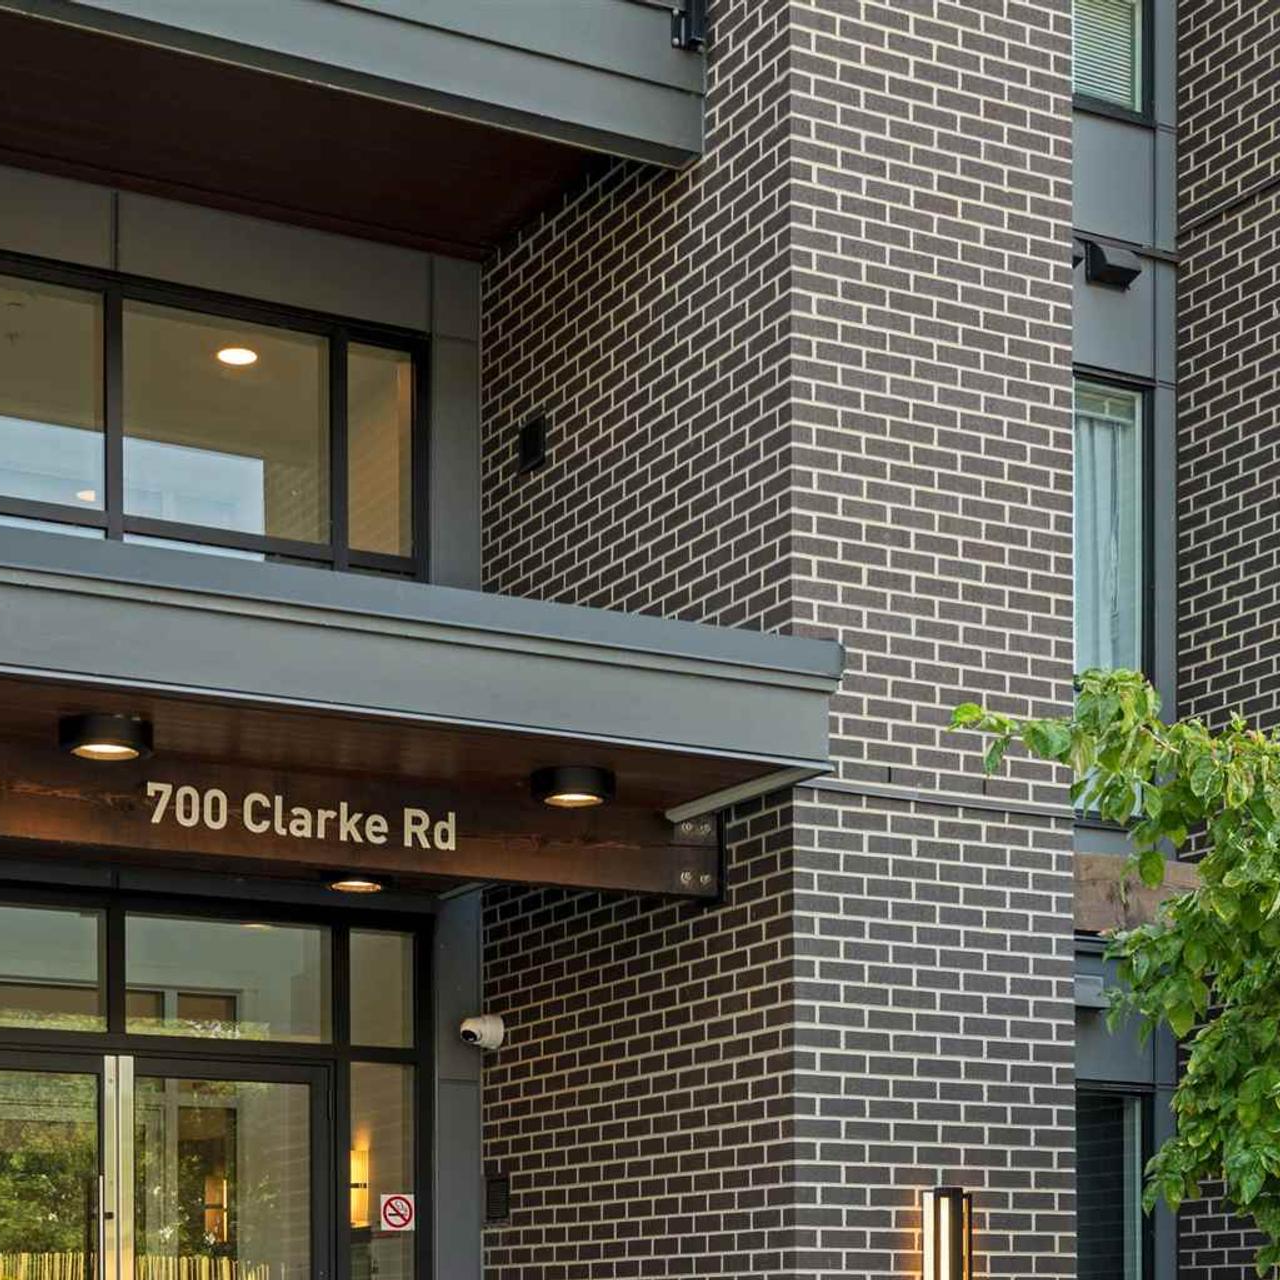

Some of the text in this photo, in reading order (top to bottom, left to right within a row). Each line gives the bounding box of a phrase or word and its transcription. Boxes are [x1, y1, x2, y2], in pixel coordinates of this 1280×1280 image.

[146, 781, 457, 851] 700 Clarke Rd
